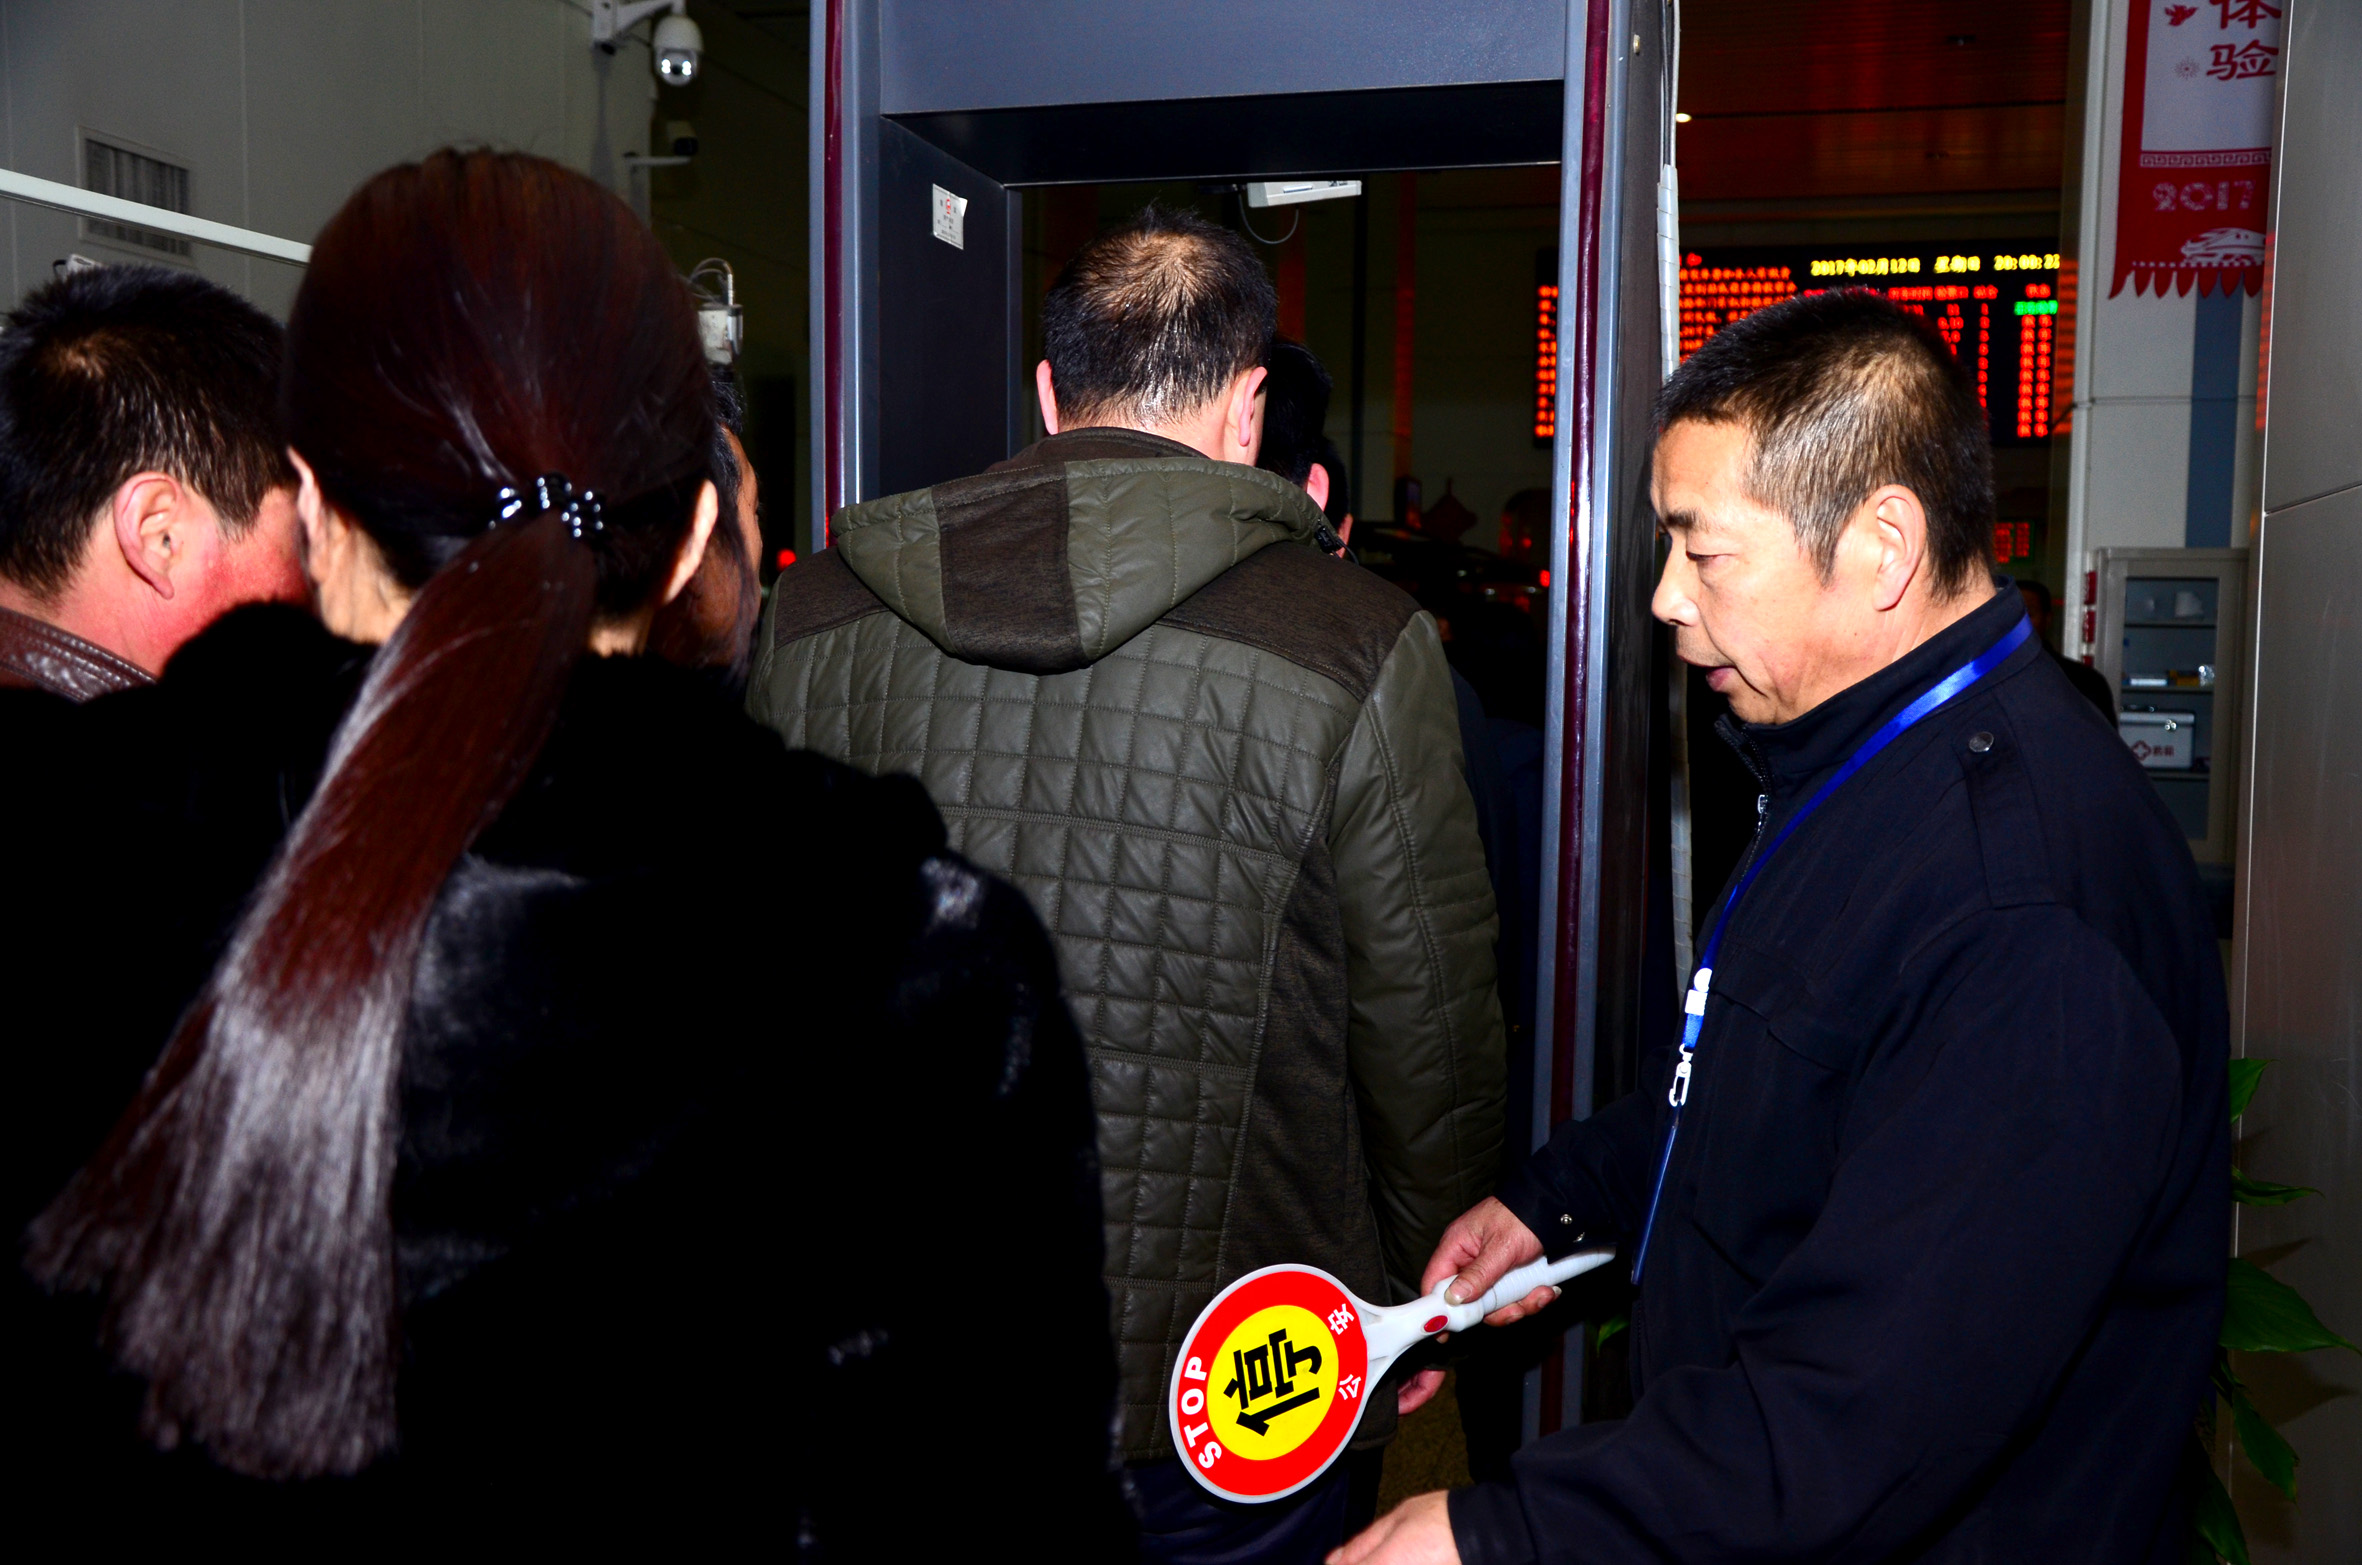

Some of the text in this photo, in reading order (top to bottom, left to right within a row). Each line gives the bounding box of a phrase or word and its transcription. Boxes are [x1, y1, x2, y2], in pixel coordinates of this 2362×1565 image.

[2152, 179, 2256, 212] 2017
[1181, 1356, 1222, 1469] STOP
[1223, 1328, 1322, 1437] 停
